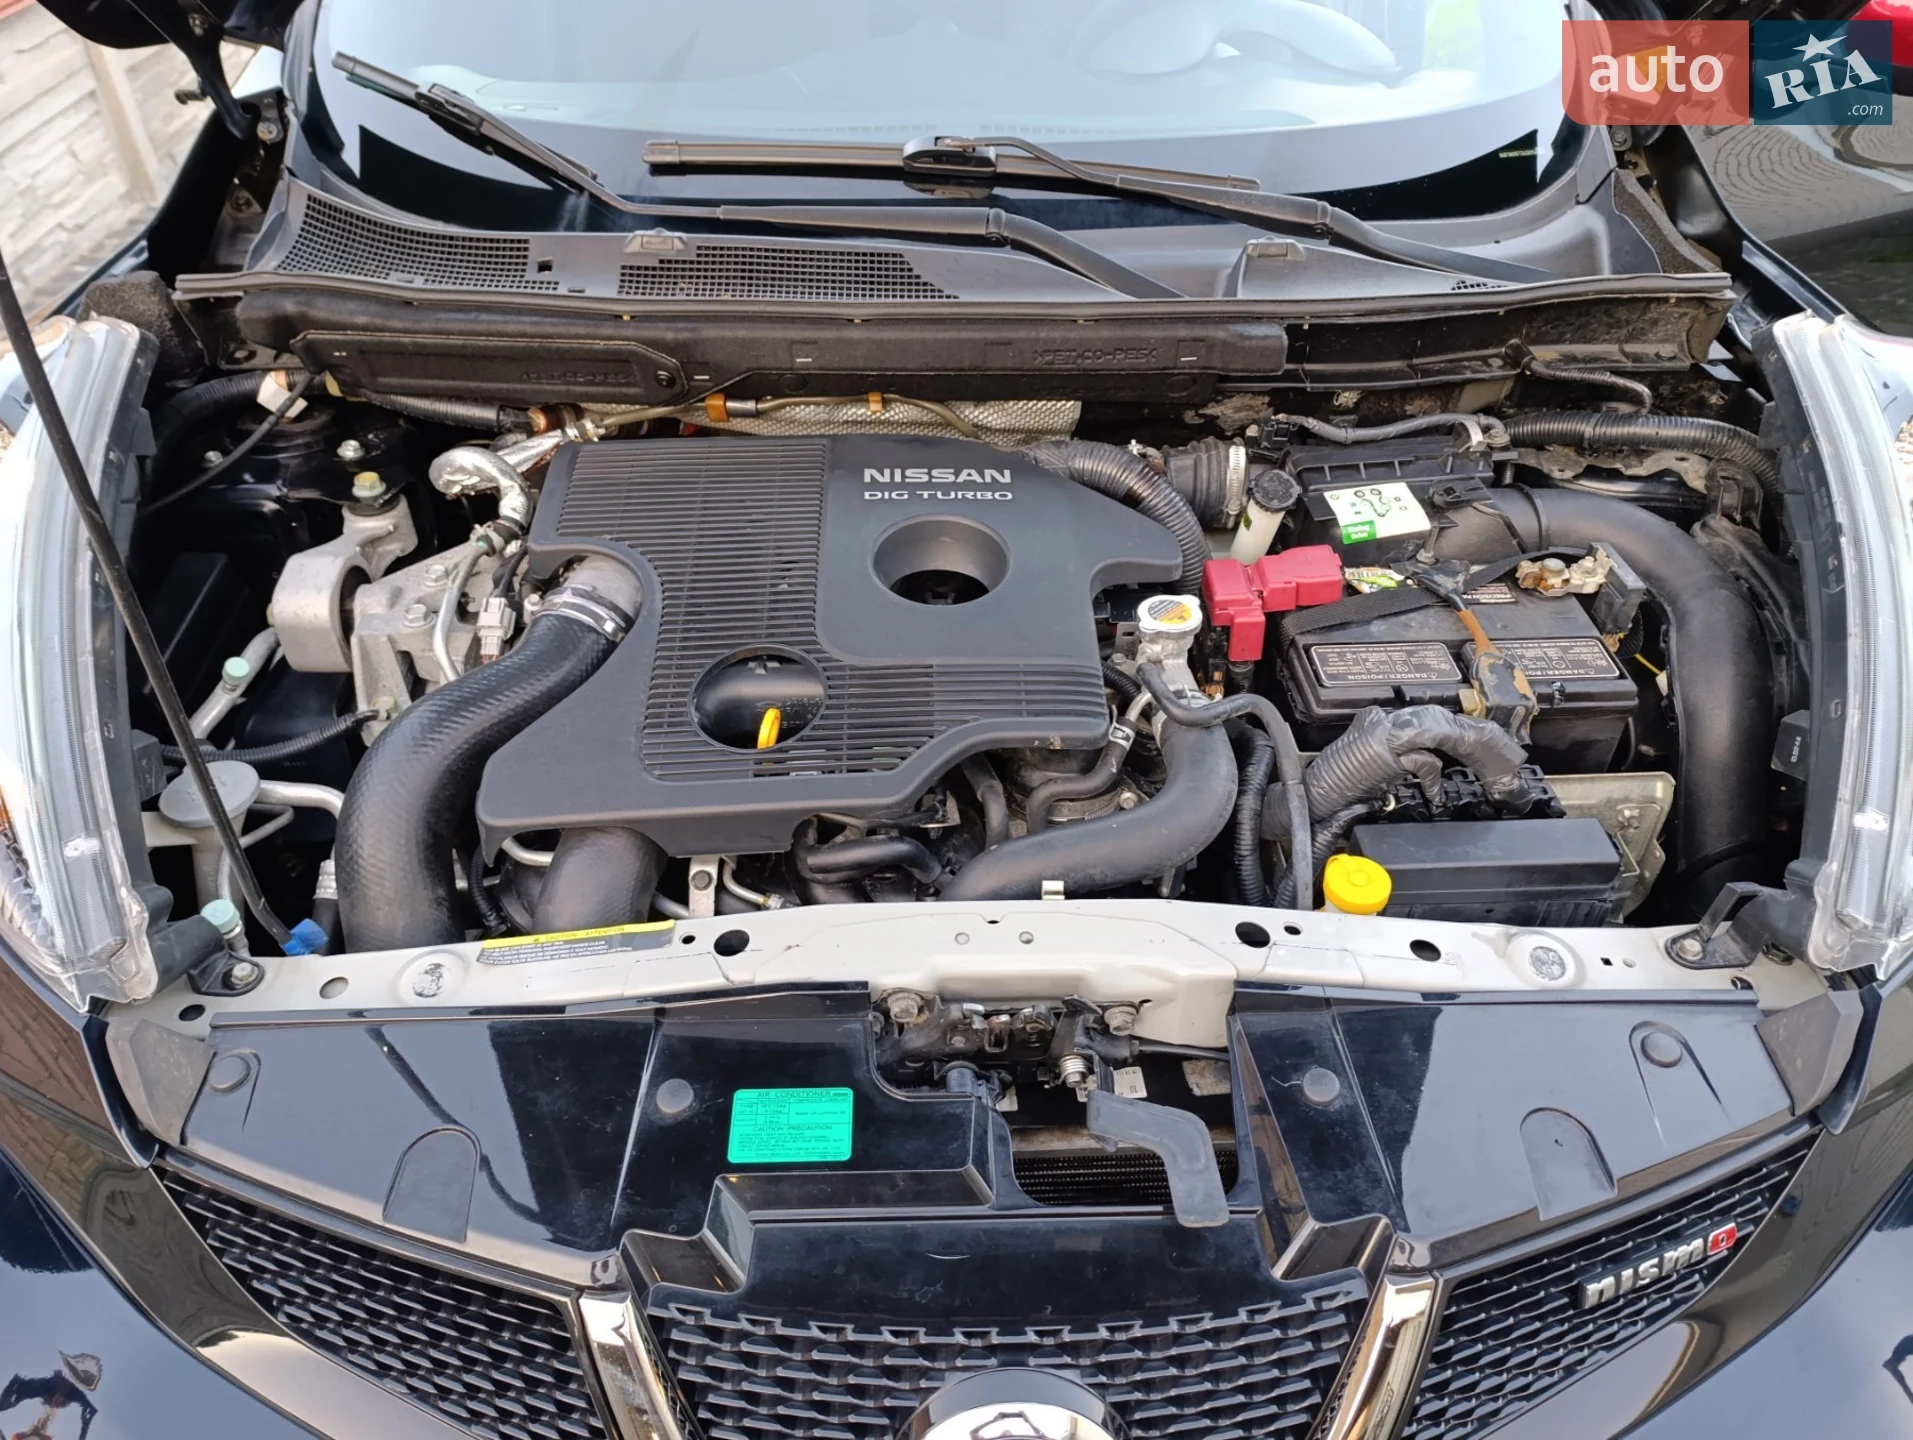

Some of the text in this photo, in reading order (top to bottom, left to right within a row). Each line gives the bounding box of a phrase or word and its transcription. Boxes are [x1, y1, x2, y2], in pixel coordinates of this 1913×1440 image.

[863, 468, 1011, 484] NISSAN
[863, 490, 1013, 501] DIG TURBO
[1389, 672, 1428, 680] DANGER
[544, 932, 578, 941] CAUTION
[584, 927, 625, 937] ATTENTION
[1585, 1222, 1738, 1309] nismo
